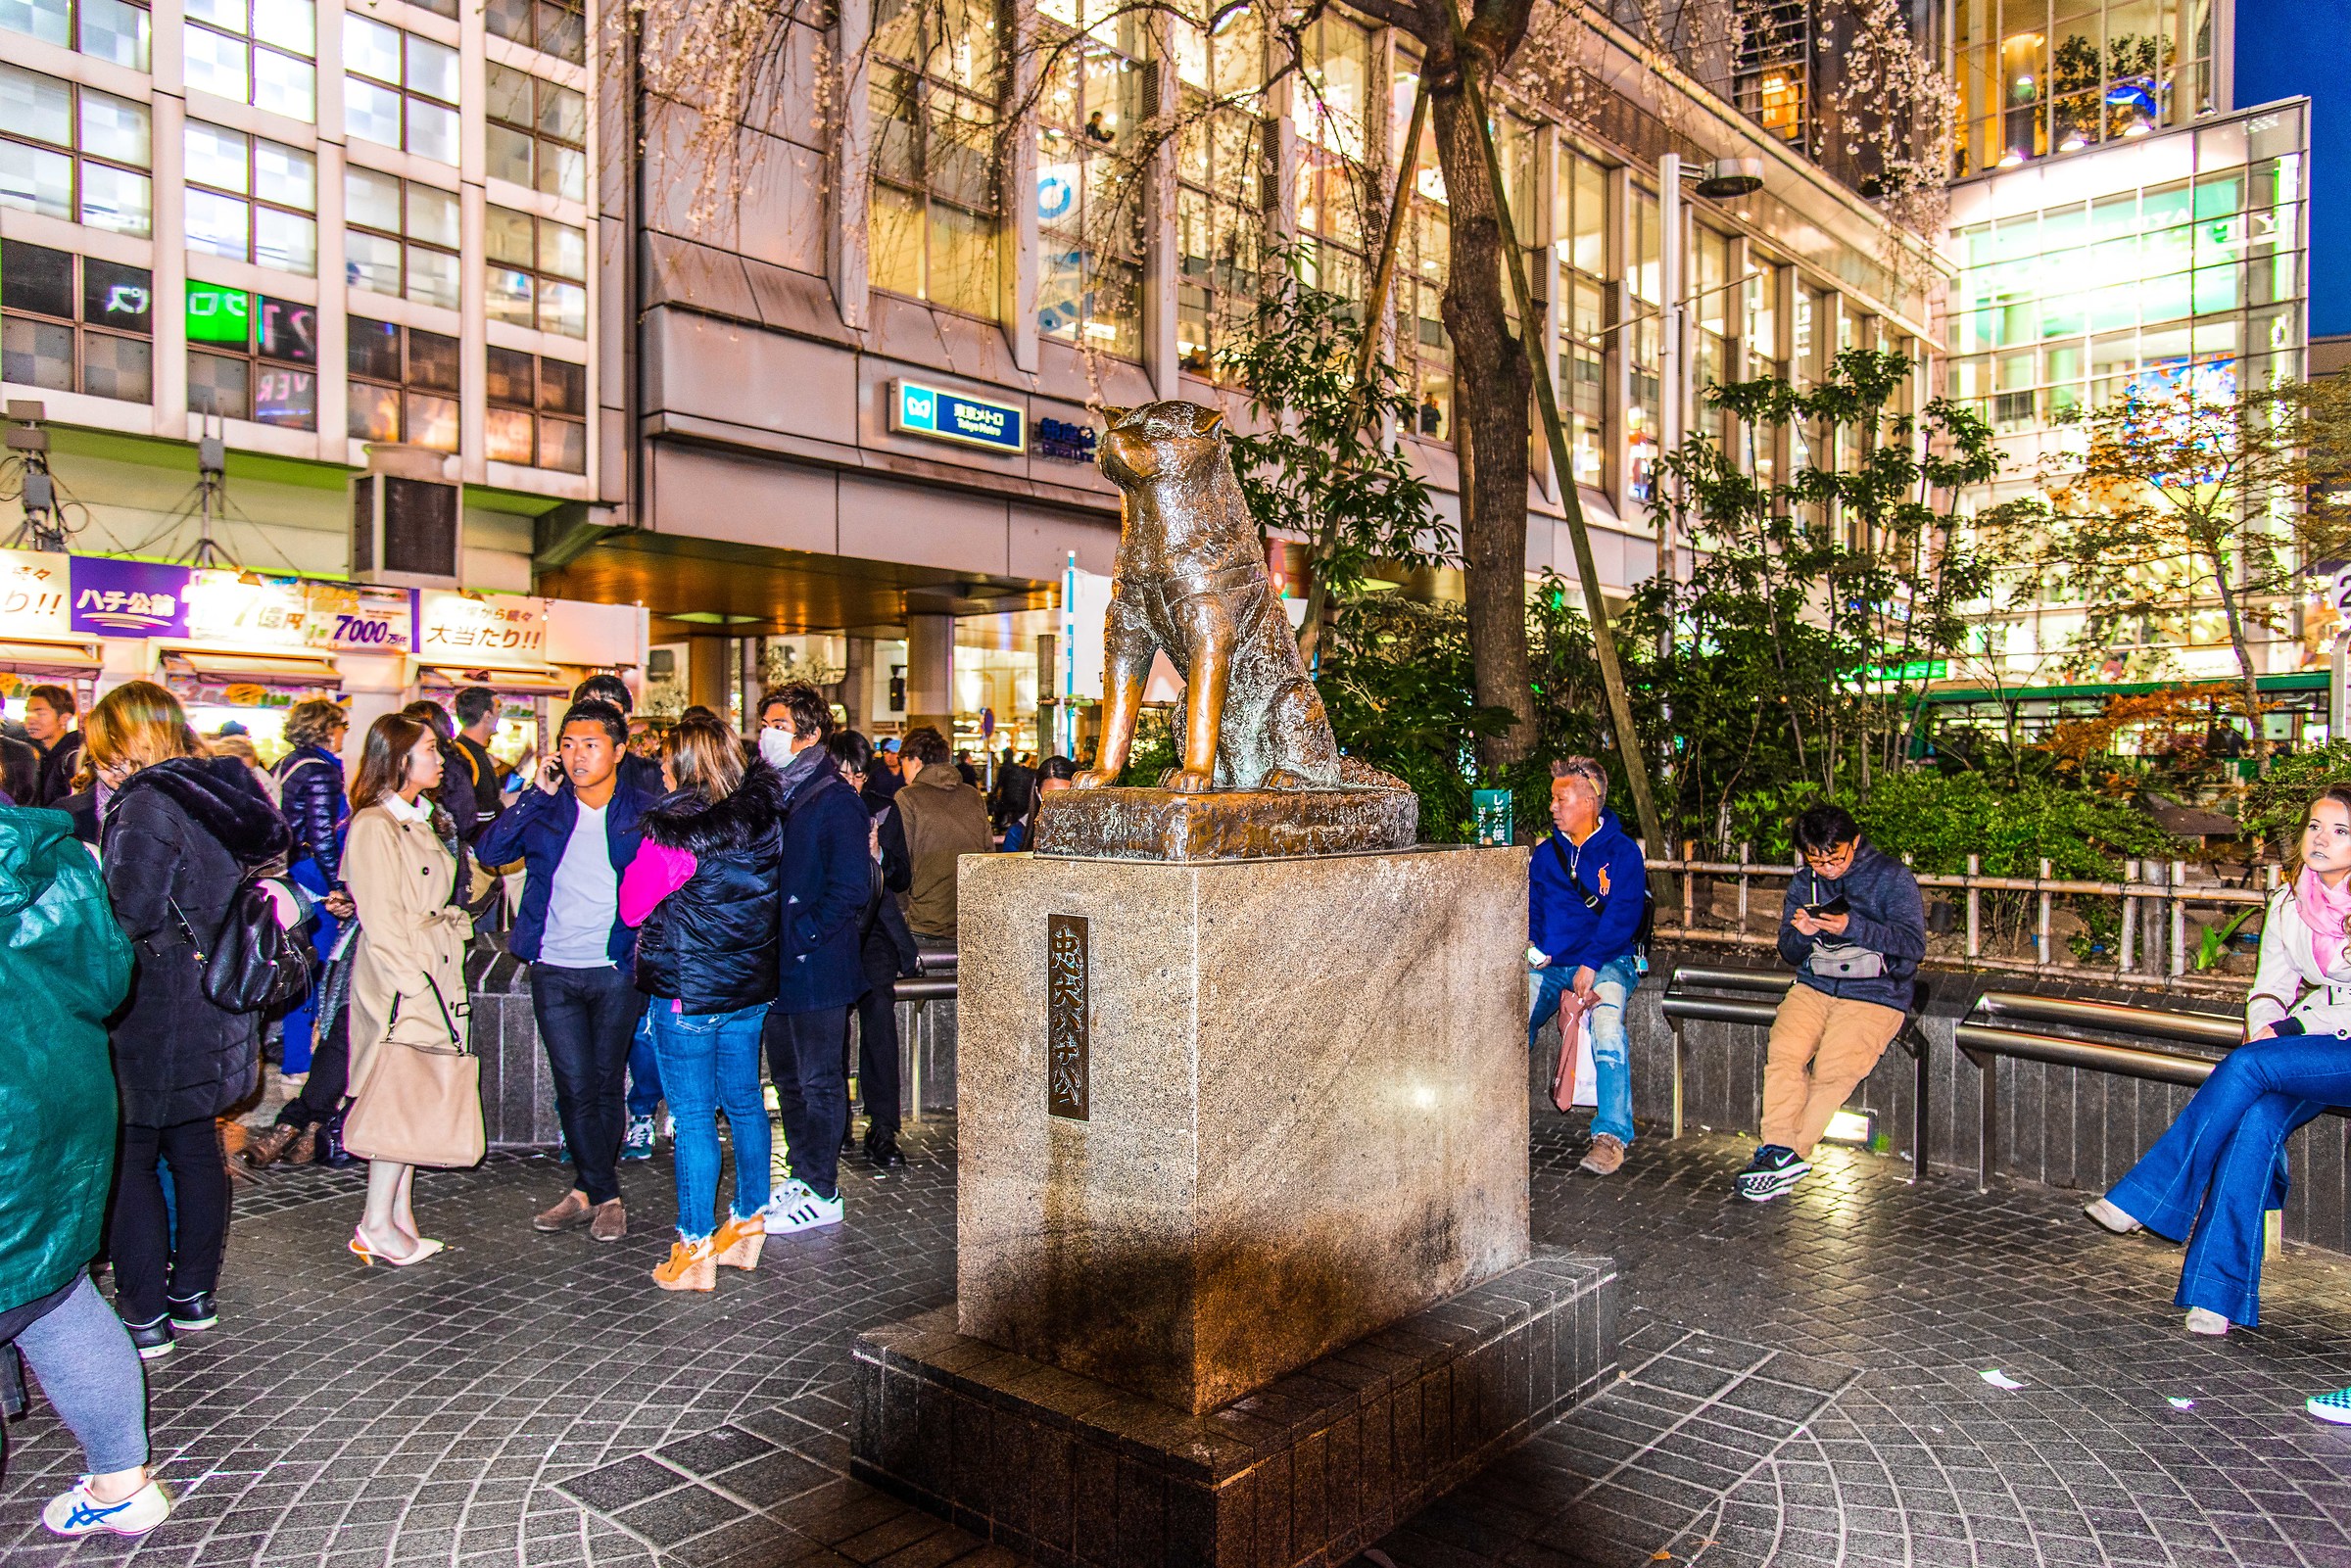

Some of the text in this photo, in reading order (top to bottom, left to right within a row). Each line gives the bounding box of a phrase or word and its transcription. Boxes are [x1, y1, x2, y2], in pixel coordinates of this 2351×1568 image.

[1051, 926, 1085, 1107] 忠犬ハチ公
